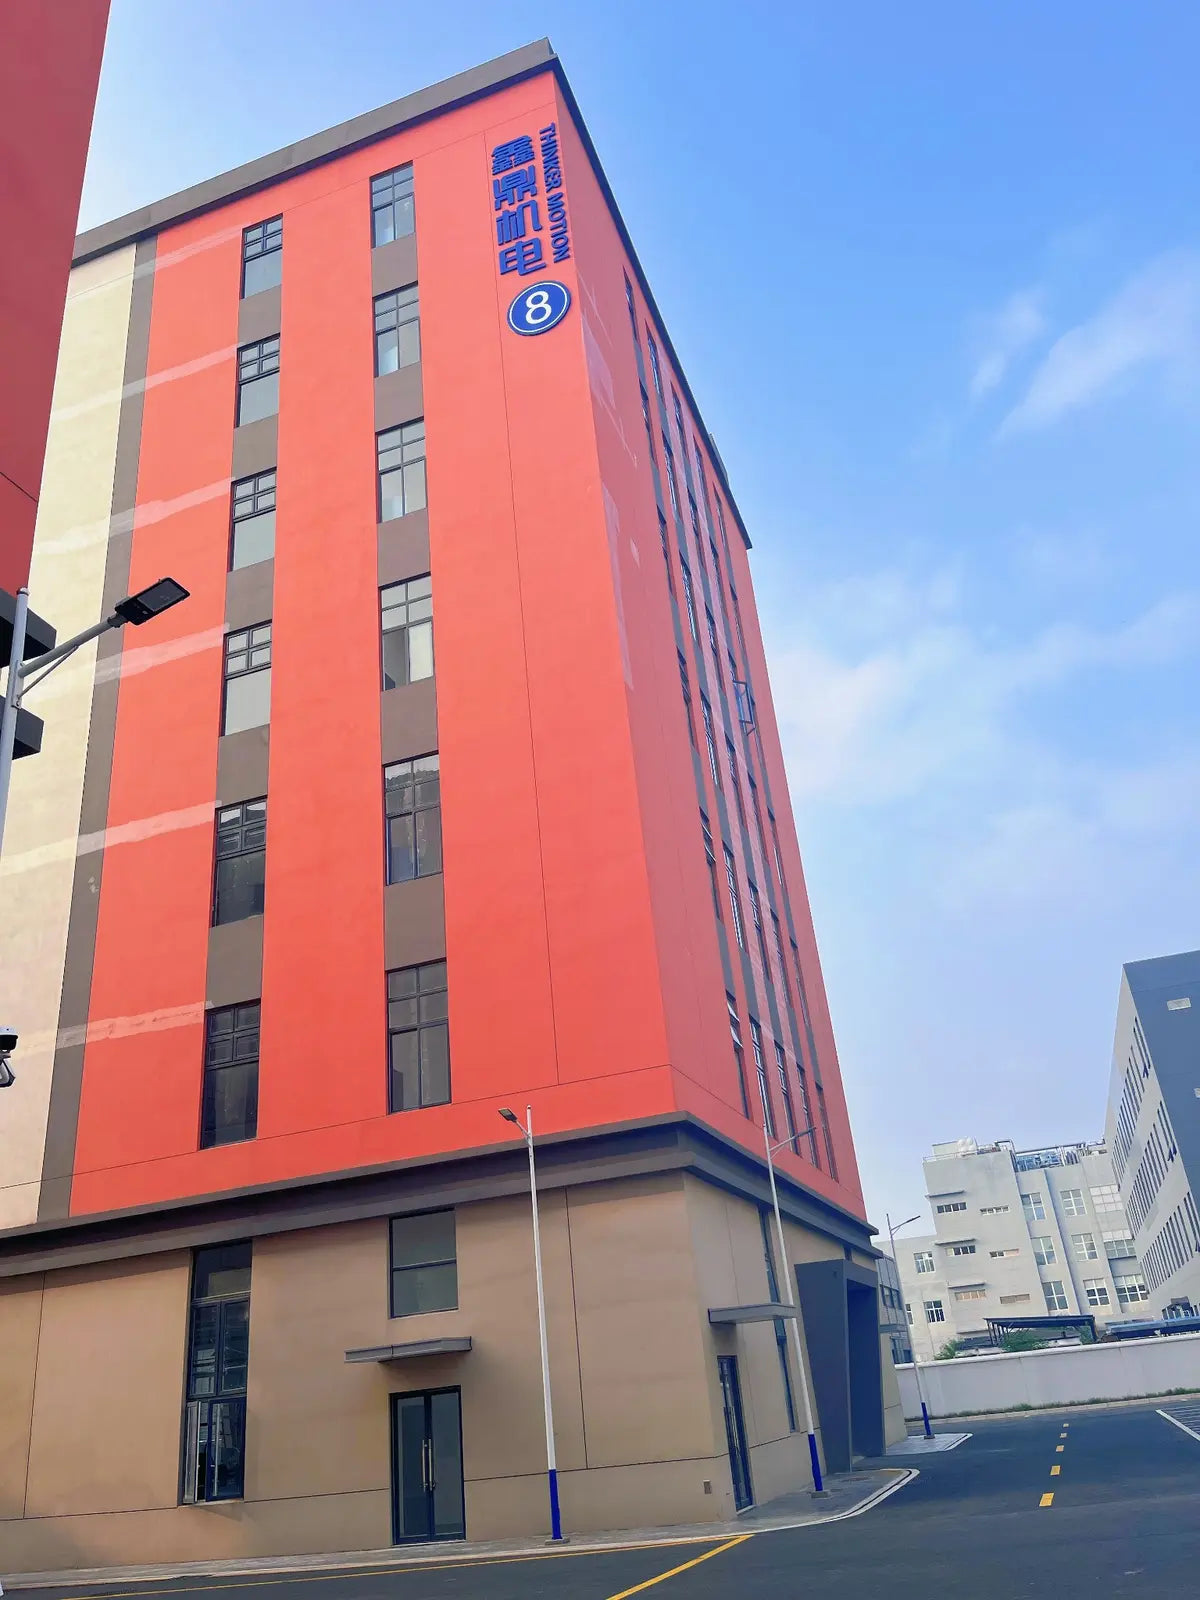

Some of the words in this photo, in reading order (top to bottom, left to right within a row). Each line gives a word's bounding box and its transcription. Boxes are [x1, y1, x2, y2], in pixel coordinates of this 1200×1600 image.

[539, 122, 562, 193] THINKER
[491, 135, 547, 276] 鑫鼎机电
[547, 192, 571, 263] MOTION
[525, 290, 552, 324] 8
